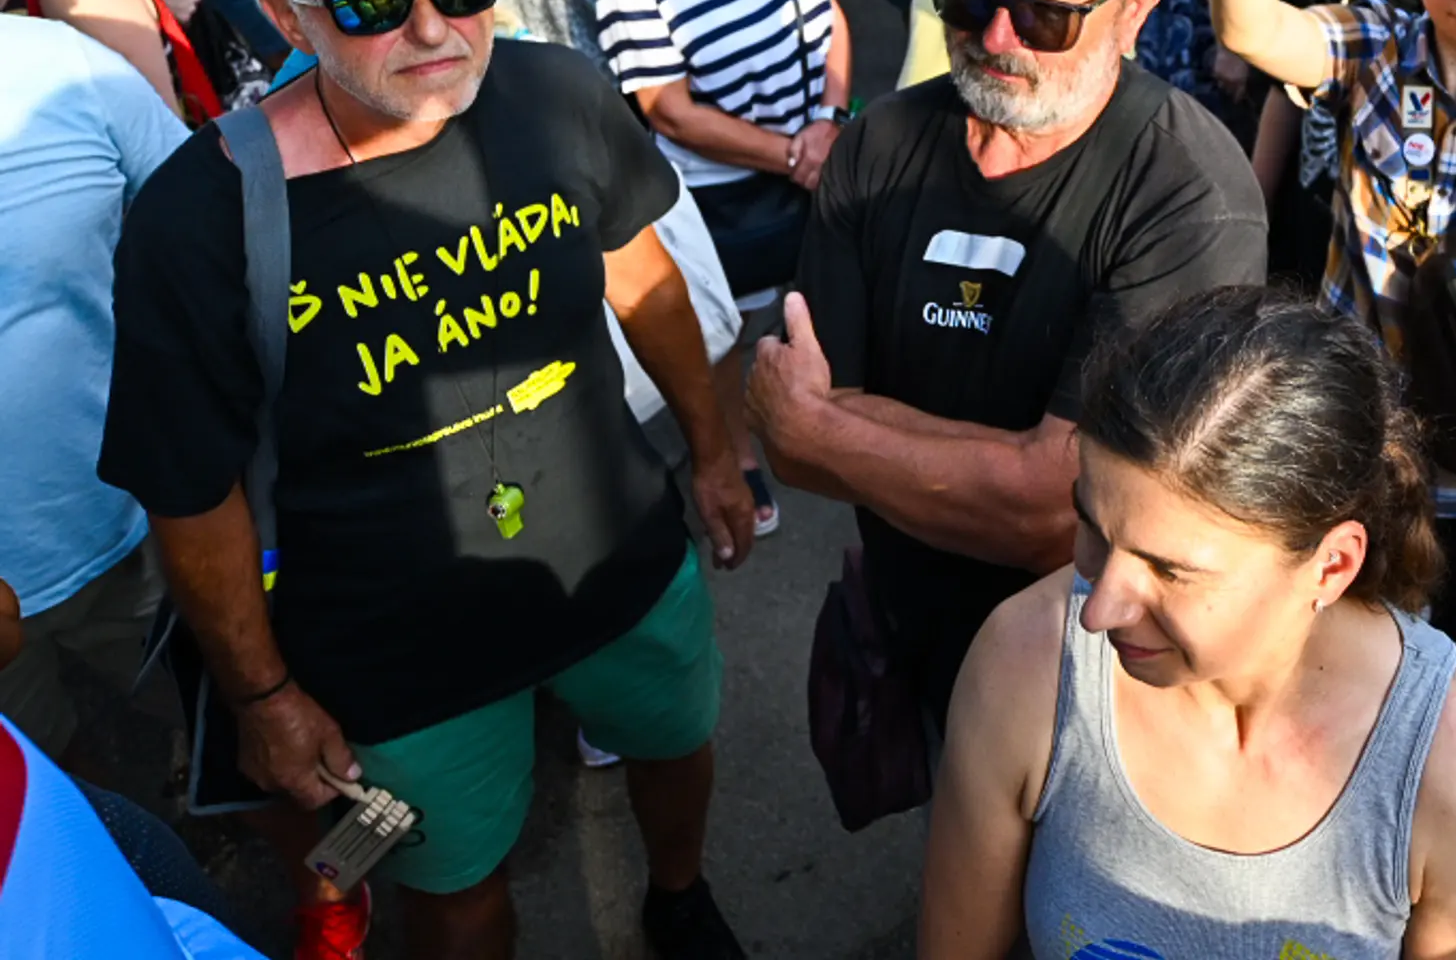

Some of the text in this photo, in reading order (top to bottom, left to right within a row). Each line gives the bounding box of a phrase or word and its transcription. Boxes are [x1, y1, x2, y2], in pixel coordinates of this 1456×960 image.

[337, 251, 429, 318] NIE
[435, 193, 580, 275] VLÁDA,
[356, 334, 420, 396] JA
[434, 268, 540, 353] ÁNO!
